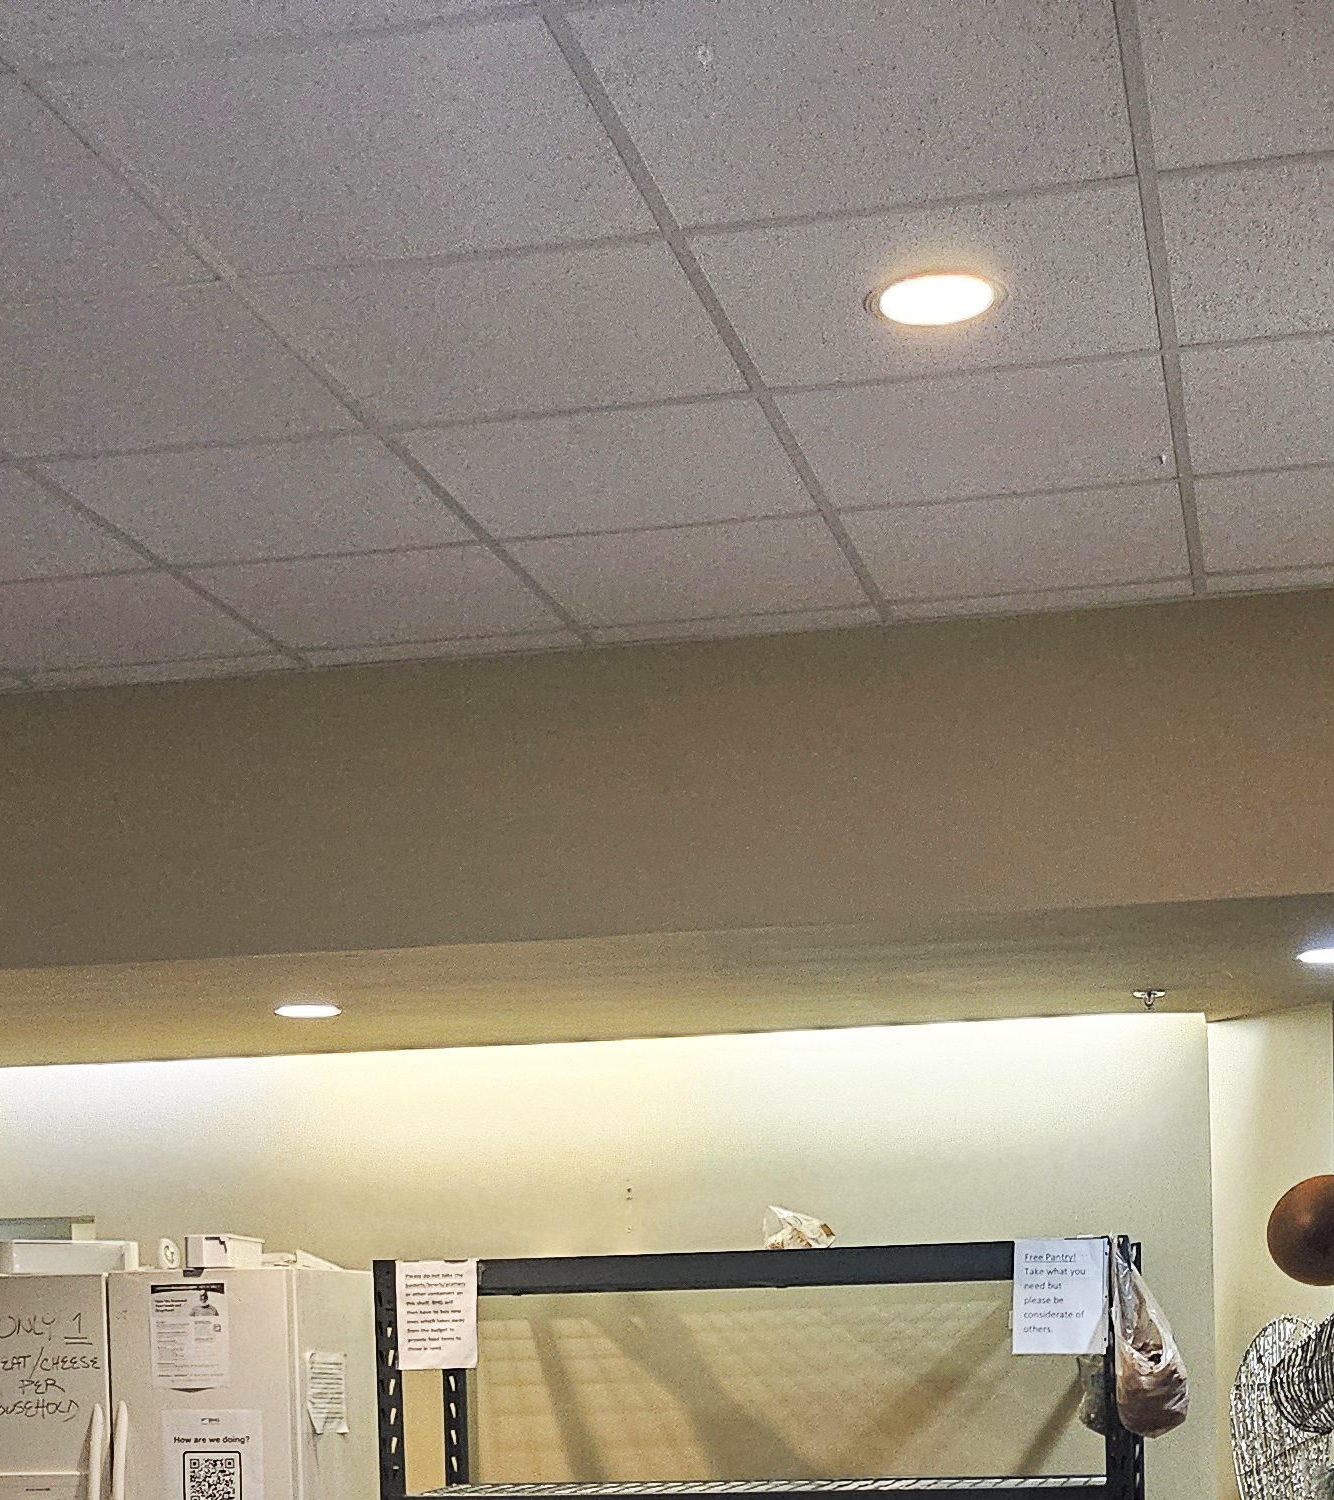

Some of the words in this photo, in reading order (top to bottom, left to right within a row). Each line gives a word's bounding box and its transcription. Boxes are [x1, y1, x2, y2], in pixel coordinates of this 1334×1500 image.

[1024, 1253, 1043, 1262] Free
[1045, 1252, 1076, 1263] Pantry!
[1024, 1267, 1045, 1276] Take
[1047, 1267, 1068, 1276] what
[1070, 1269, 1086, 1277] you
[1024, 1281, 1045, 1290] need
[1047, 1281, 1062, 1290] but
[1024, 1296, 1051, 1305] please
[1053, 1295, 1064, 1304] be
[1023, 1310, 1073, 1319] considerate
[1075, 1310, 1085, 1319] of
[1023, 1325, 1054, 1334] others.
[19, 1377, 65, 1395] PER
[173, 1436, 192, 1444] How
[222, 1435, 250, 1445] doing?
